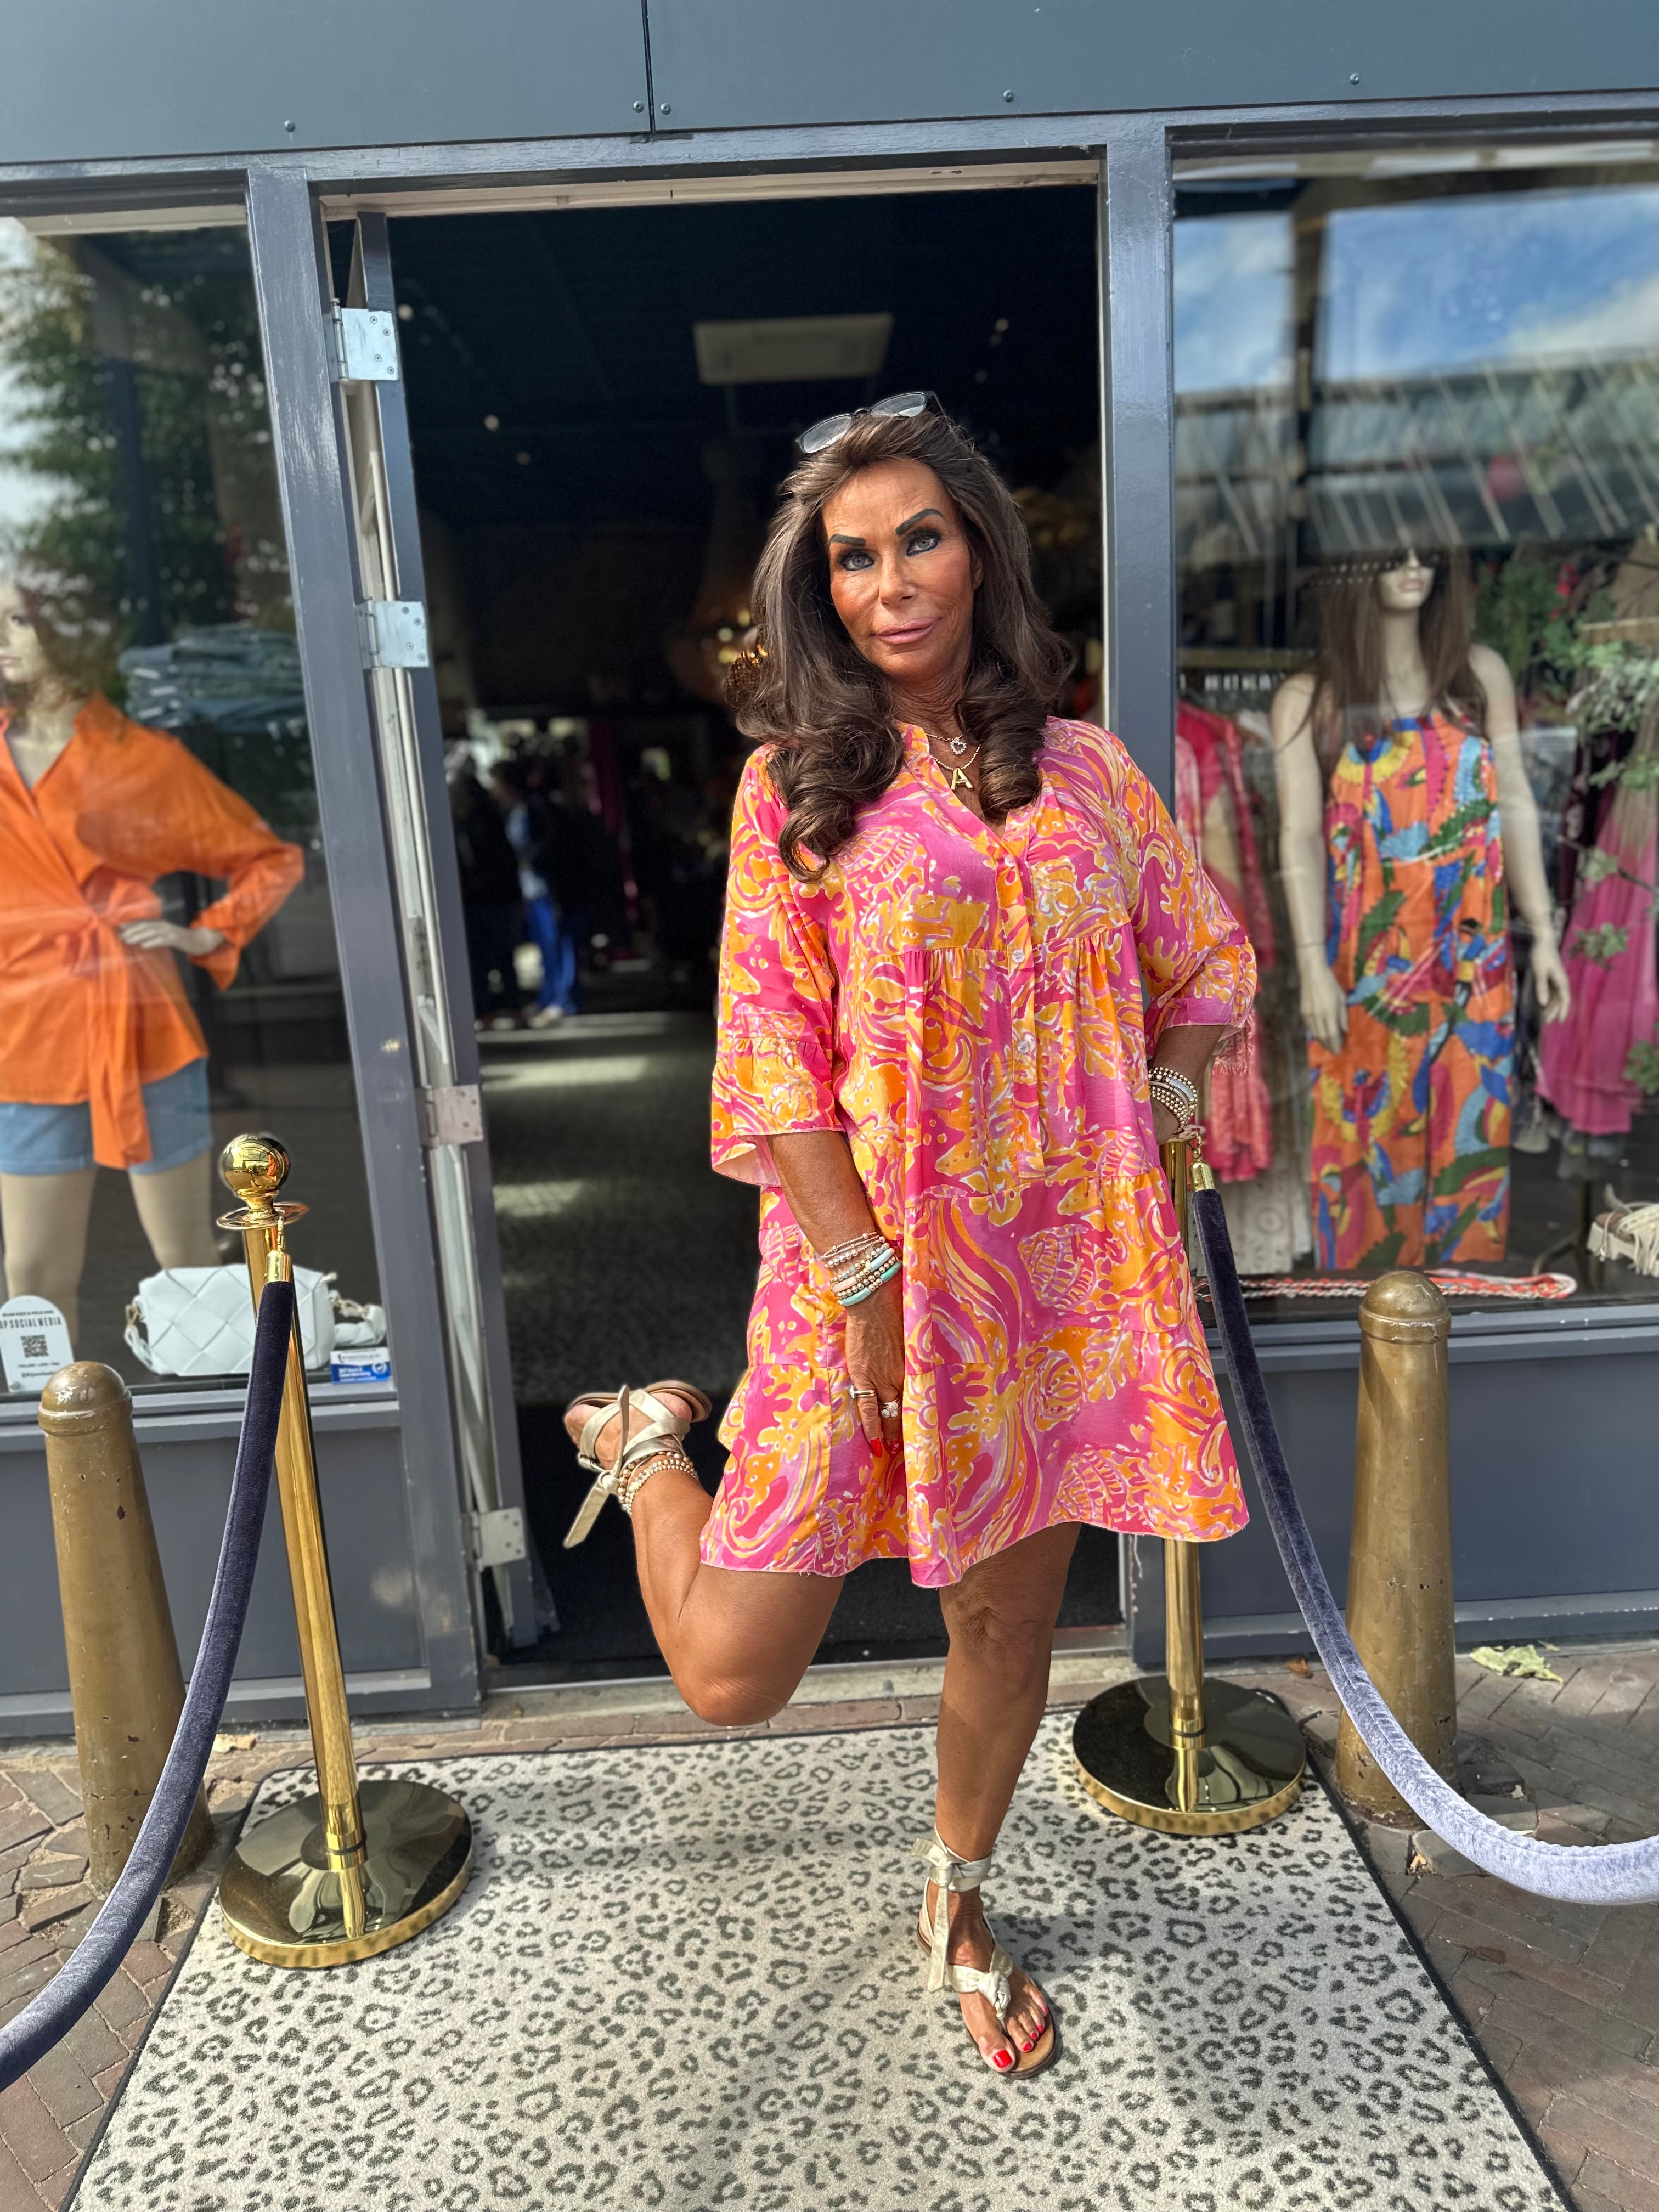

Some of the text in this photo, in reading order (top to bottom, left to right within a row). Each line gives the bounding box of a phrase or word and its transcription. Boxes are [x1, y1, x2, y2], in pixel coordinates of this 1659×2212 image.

[951, 767, 974, 790] A
[9, 1318, 37, 1328] SOCIAL
[38, 1316, 62, 1326] MEDIA
